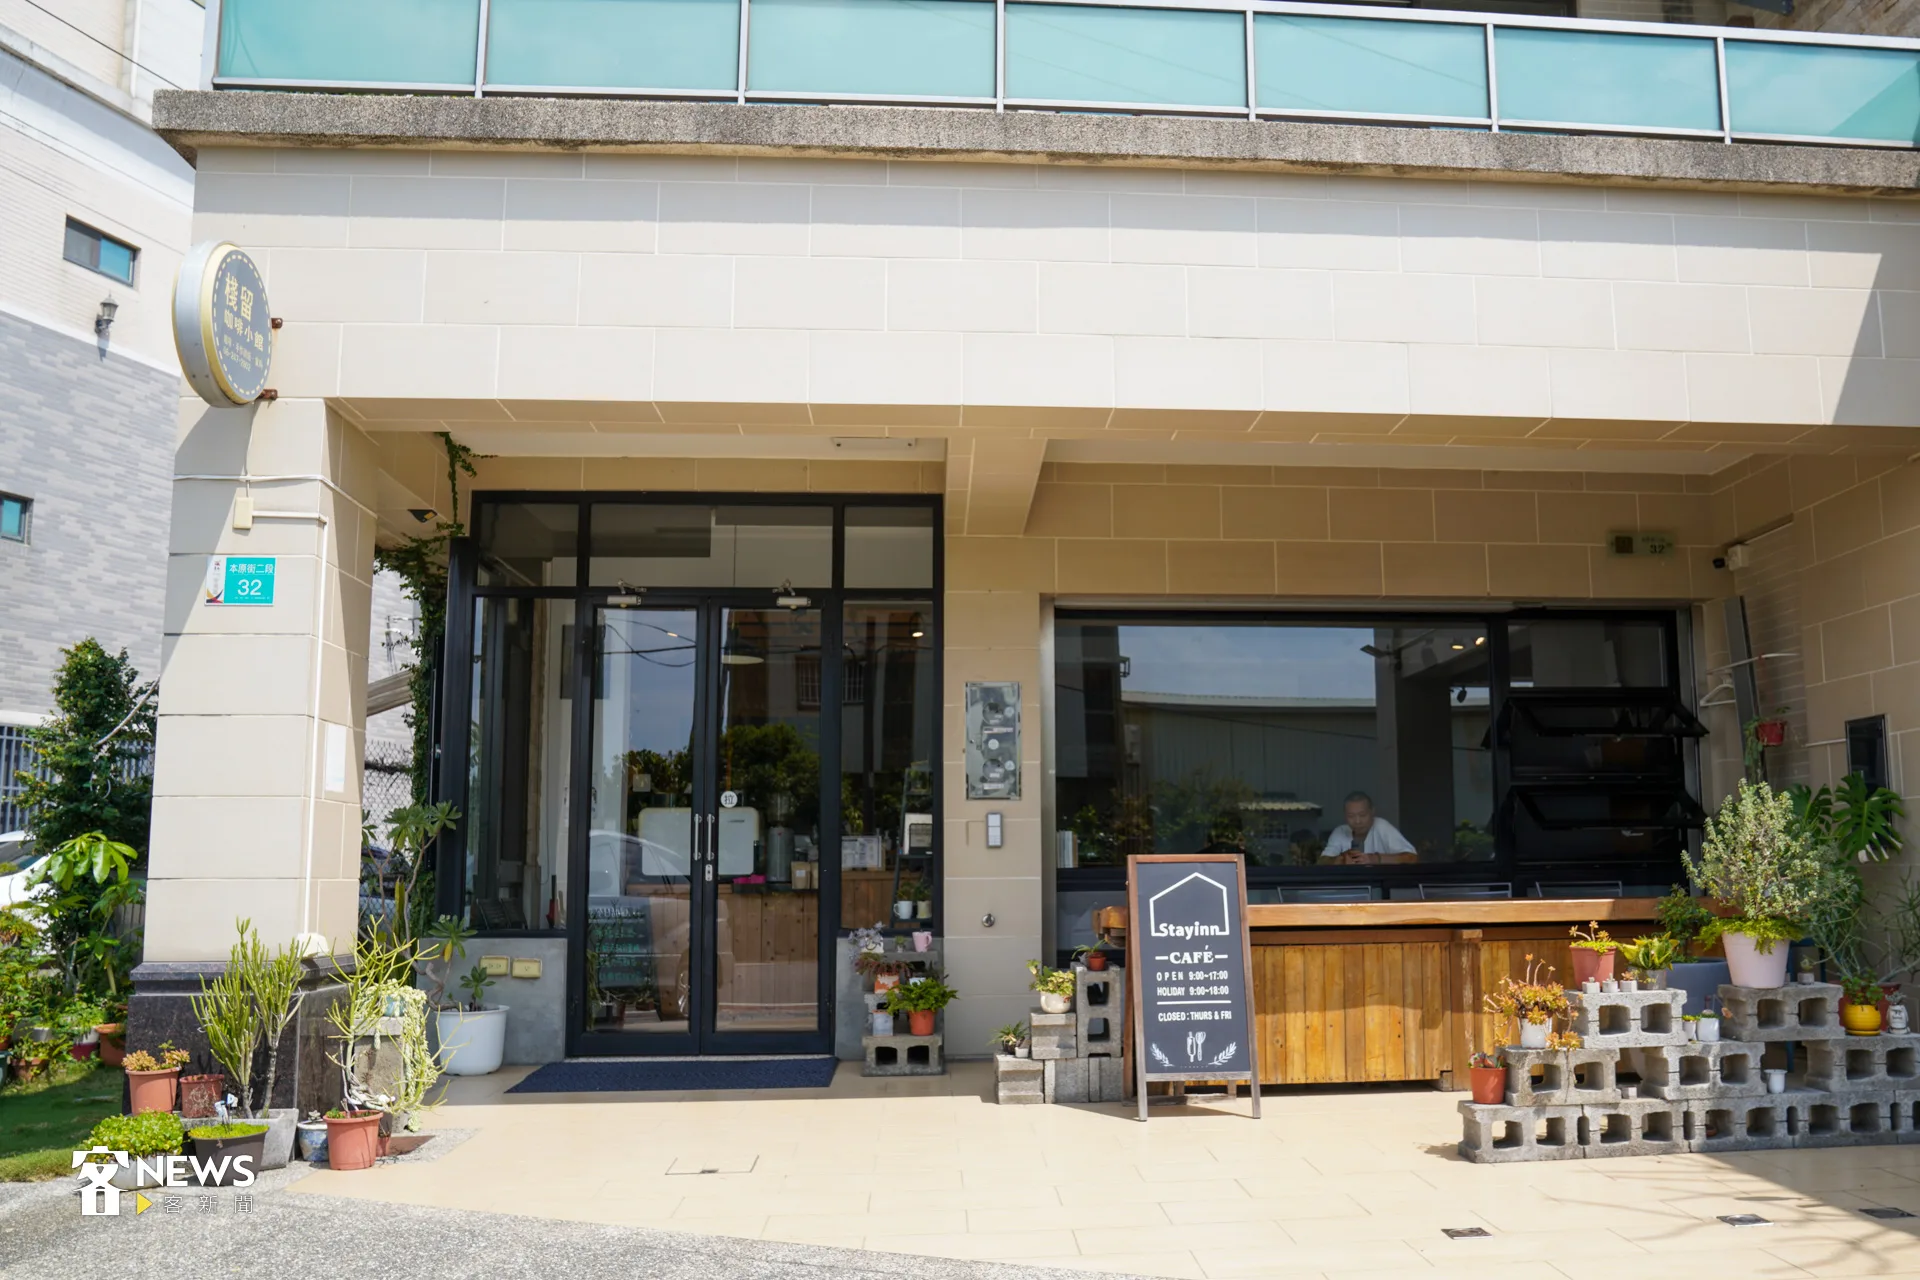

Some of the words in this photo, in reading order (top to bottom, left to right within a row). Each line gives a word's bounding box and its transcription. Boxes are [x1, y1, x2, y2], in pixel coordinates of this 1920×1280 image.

[224, 271, 254, 322] 棧留
[223, 309, 264, 352] 咖啡小館
[1650, 543, 1665, 554] 32
[229, 563, 274, 574] 本原街二段
[237, 578, 262, 596] 32
[1159, 921, 1220, 940] Stayinn
[1169, 944, 1214, 964] CAFÉ
[1156, 971, 1184, 982] OPEN
[1188, 970, 1229, 981] 9:00~17:00
[1156, 986, 1186, 996] HOLIDAY
[1189, 985, 1230, 996] 9:00~18:00
[1214, 1010, 1220, 1020] &
[1220, 1010, 1232, 1020] FRI
